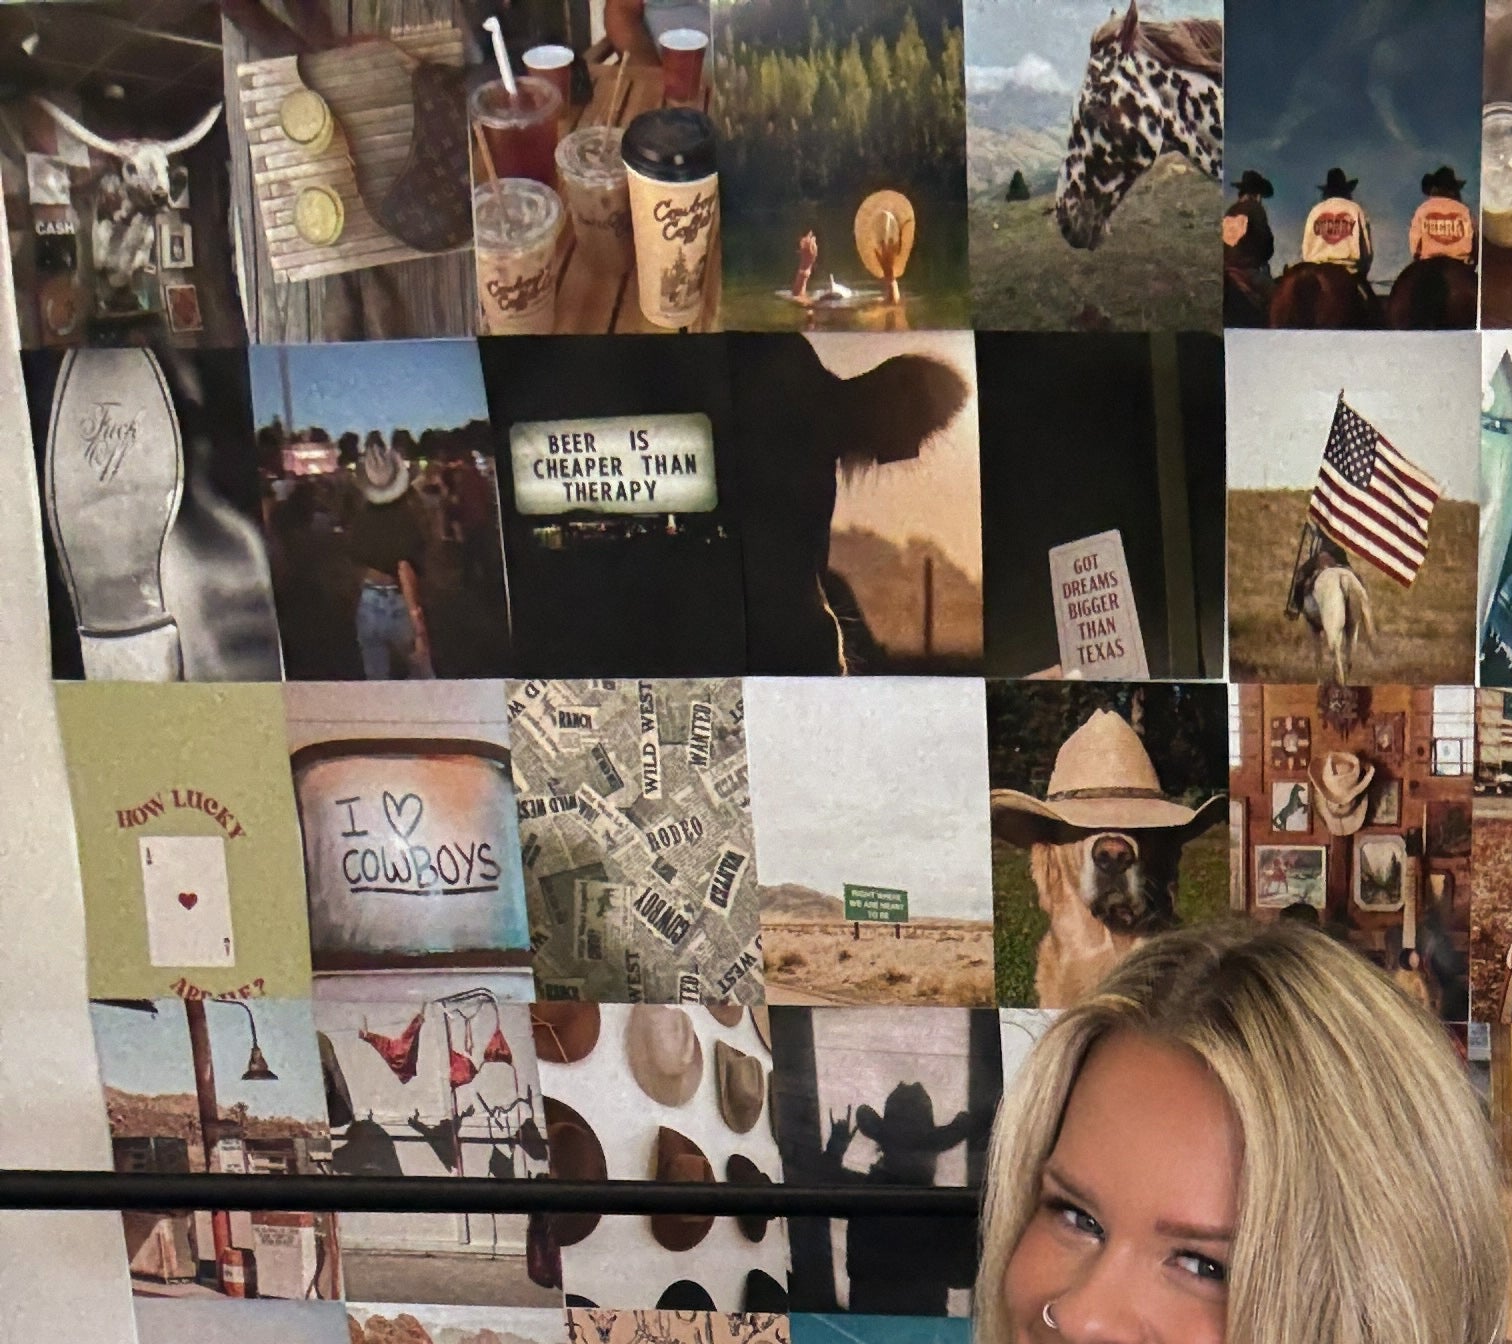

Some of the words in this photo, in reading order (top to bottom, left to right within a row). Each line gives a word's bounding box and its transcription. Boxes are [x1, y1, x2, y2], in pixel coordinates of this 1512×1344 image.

[35, 221, 75, 236] CASH
[548, 432, 597, 454] BEER
[629, 429, 650, 451] IS
[533, 456, 623, 480] CHEAPER
[641, 453, 697, 477] THAN
[563, 480, 657, 502] THERAPY
[1073, 553, 1098, 575] GOT
[1062, 570, 1118, 599] DREAMS
[1068, 592, 1120, 620] BIGGER
[1078, 616, 1117, 641] THAN
[1077, 638, 1125, 665] TEXAS
[638, 680, 655, 734] WEST
[689, 703, 711, 767] WANTED
[643, 743, 658, 795] WILD
[116, 792, 166, 829] HOW
[171, 789, 247, 840] LUCKY
[335, 796, 368, 837] I
[646, 815, 704, 852] RODEO
[342, 842, 501, 888] COWBOYS
